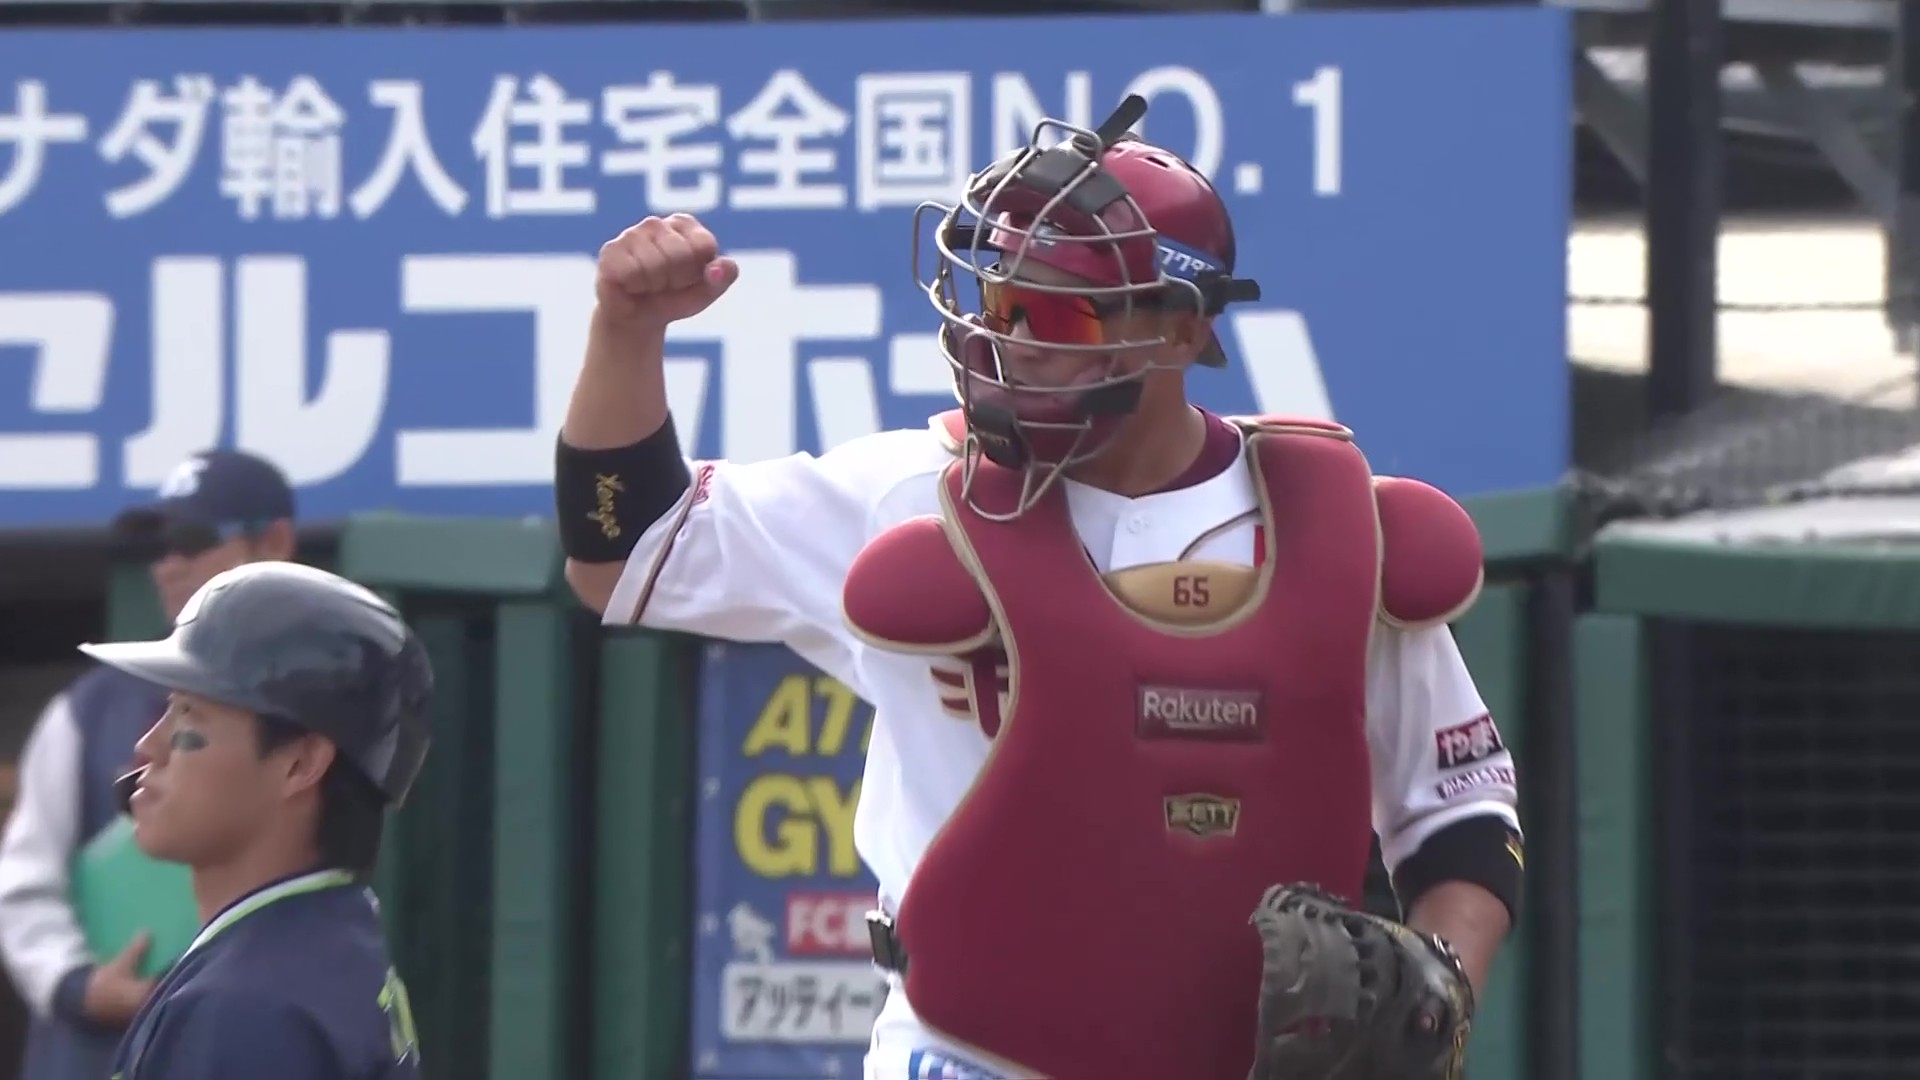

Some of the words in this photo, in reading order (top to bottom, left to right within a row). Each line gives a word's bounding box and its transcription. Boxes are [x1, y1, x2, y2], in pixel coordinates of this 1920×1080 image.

[1173, 576, 1210, 608] 65
[742, 673, 876, 758] AT
[1143, 690, 1257, 725] Rakuten
